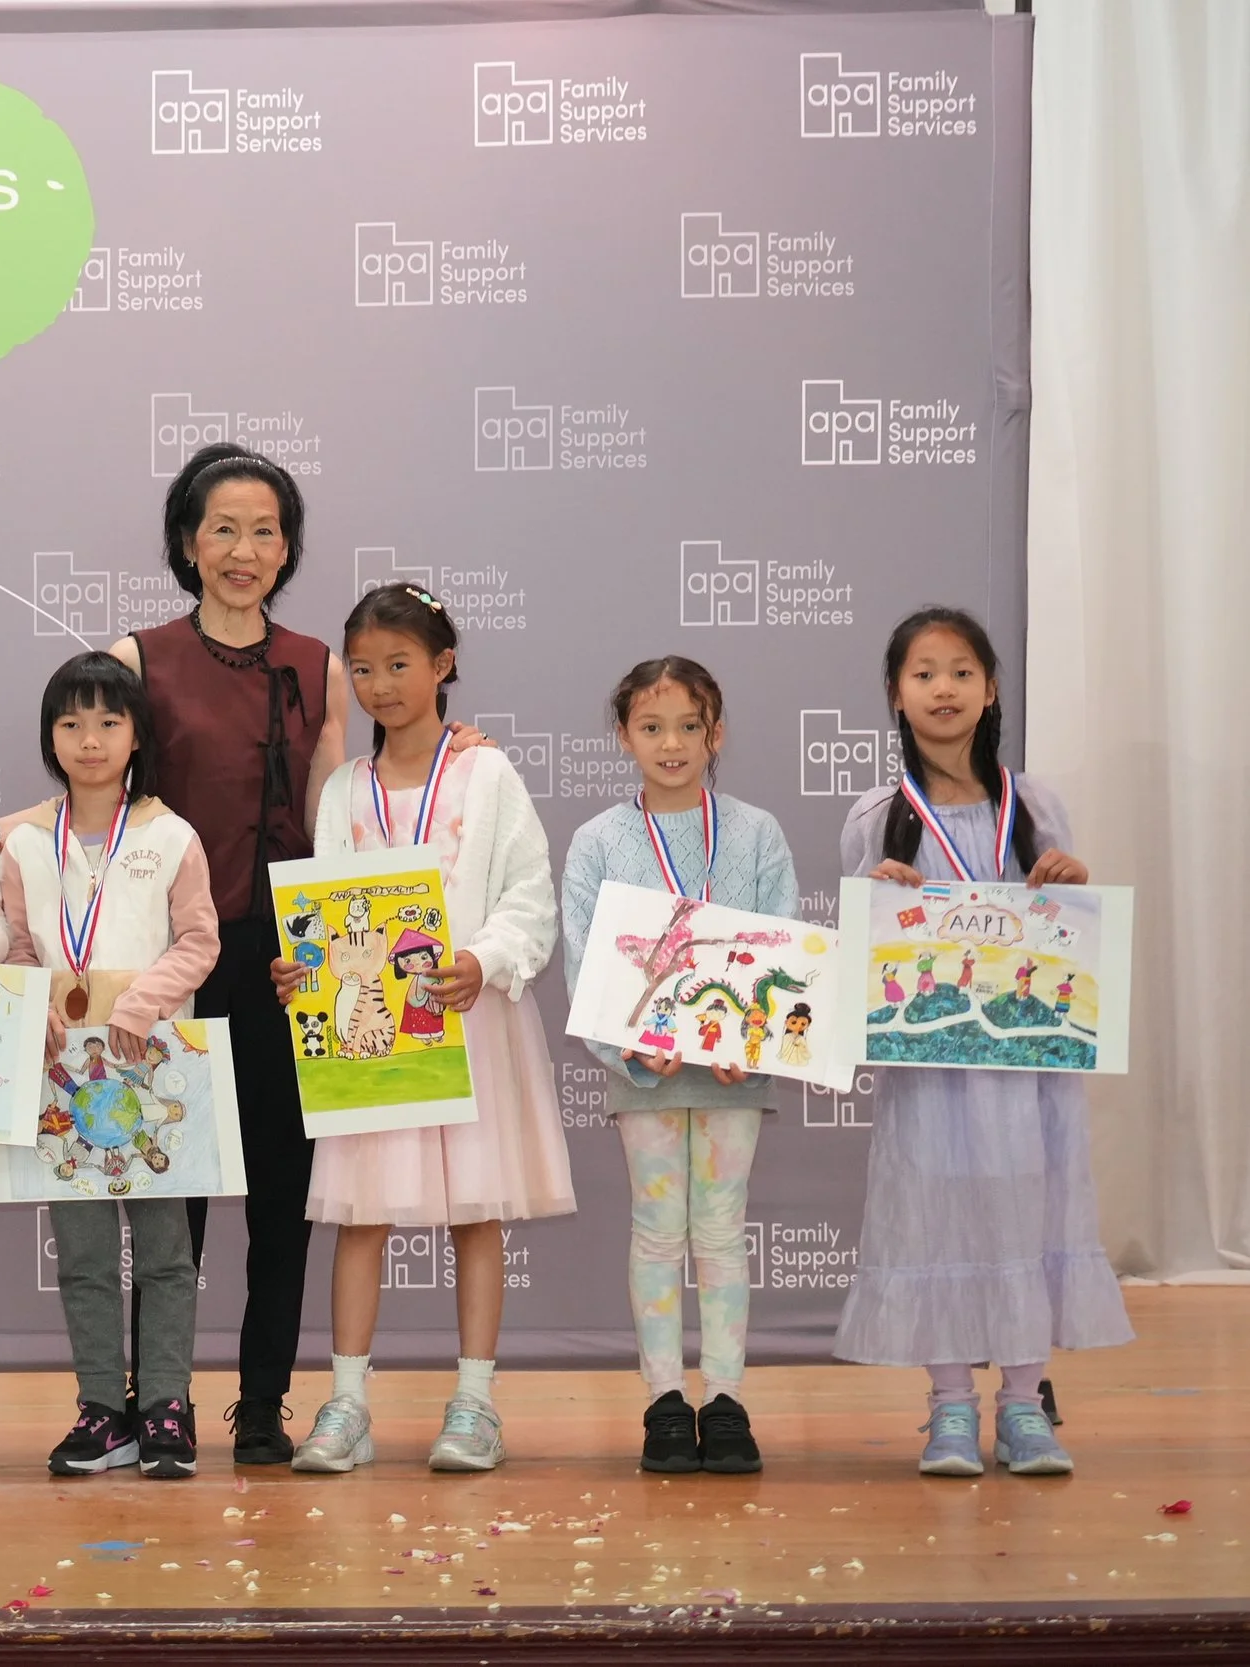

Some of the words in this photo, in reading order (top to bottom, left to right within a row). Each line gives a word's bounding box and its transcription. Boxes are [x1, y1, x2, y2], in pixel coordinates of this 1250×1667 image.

[560, 77, 628, 103] Family
[888, 70, 958, 96] Family
[236, 88, 304, 114] Family
[481, 89, 547, 123] apa
[808, 82, 875, 114] apa
[888, 92, 976, 117] Support
[159, 100, 223, 132] apa
[236, 110, 321, 135] Support
[560, 99, 646, 124] Support
[560, 122, 647, 143] Services
[888, 115, 976, 137] Services
[236, 133, 322, 153] Services
[441, 239, 509, 265] Family
[768, 231, 836, 257] Family
[118, 246, 186, 272] Family
[363, 251, 427, 284] apa
[688, 242, 754, 275] apa
[767, 253, 853, 278] Support
[118, 268, 202, 293] Support
[441, 261, 526, 286] Support
[441, 284, 527, 304] Services
[767, 276, 854, 297] Services
[118, 291, 203, 311] Services
[236, 411, 304, 436] Family
[561, 404, 629, 430] Family
[889, 399, 959, 425] Family
[481, 413, 547, 447] apa
[809, 409, 876, 441] apa
[889, 421, 976, 446] Support
[159, 423, 223, 453] apa
[561, 426, 646, 451] Support
[561, 449, 647, 470] Services
[889, 444, 976, 465] Services
[440, 565, 508, 590] Family
[766, 559, 835, 585] Family
[41, 581, 105, 613] apa
[687, 569, 753, 602] apa
[766, 581, 852, 606] Support
[118, 594, 196, 618] Suppor
[440, 589, 526, 613] Support
[449, 611, 527, 630] ervices
[766, 604, 853, 625] Services
[498, 744, 547, 768] pa
[560, 756, 638, 780] Suppor
[808, 741, 873, 771] apa
[800, 890, 836, 916] mily
[949, 914, 1007, 937] AAPI
[771, 1222, 841, 1247] Family
[383, 1234, 430, 1263] pa
[771, 1246, 859, 1270] Support
